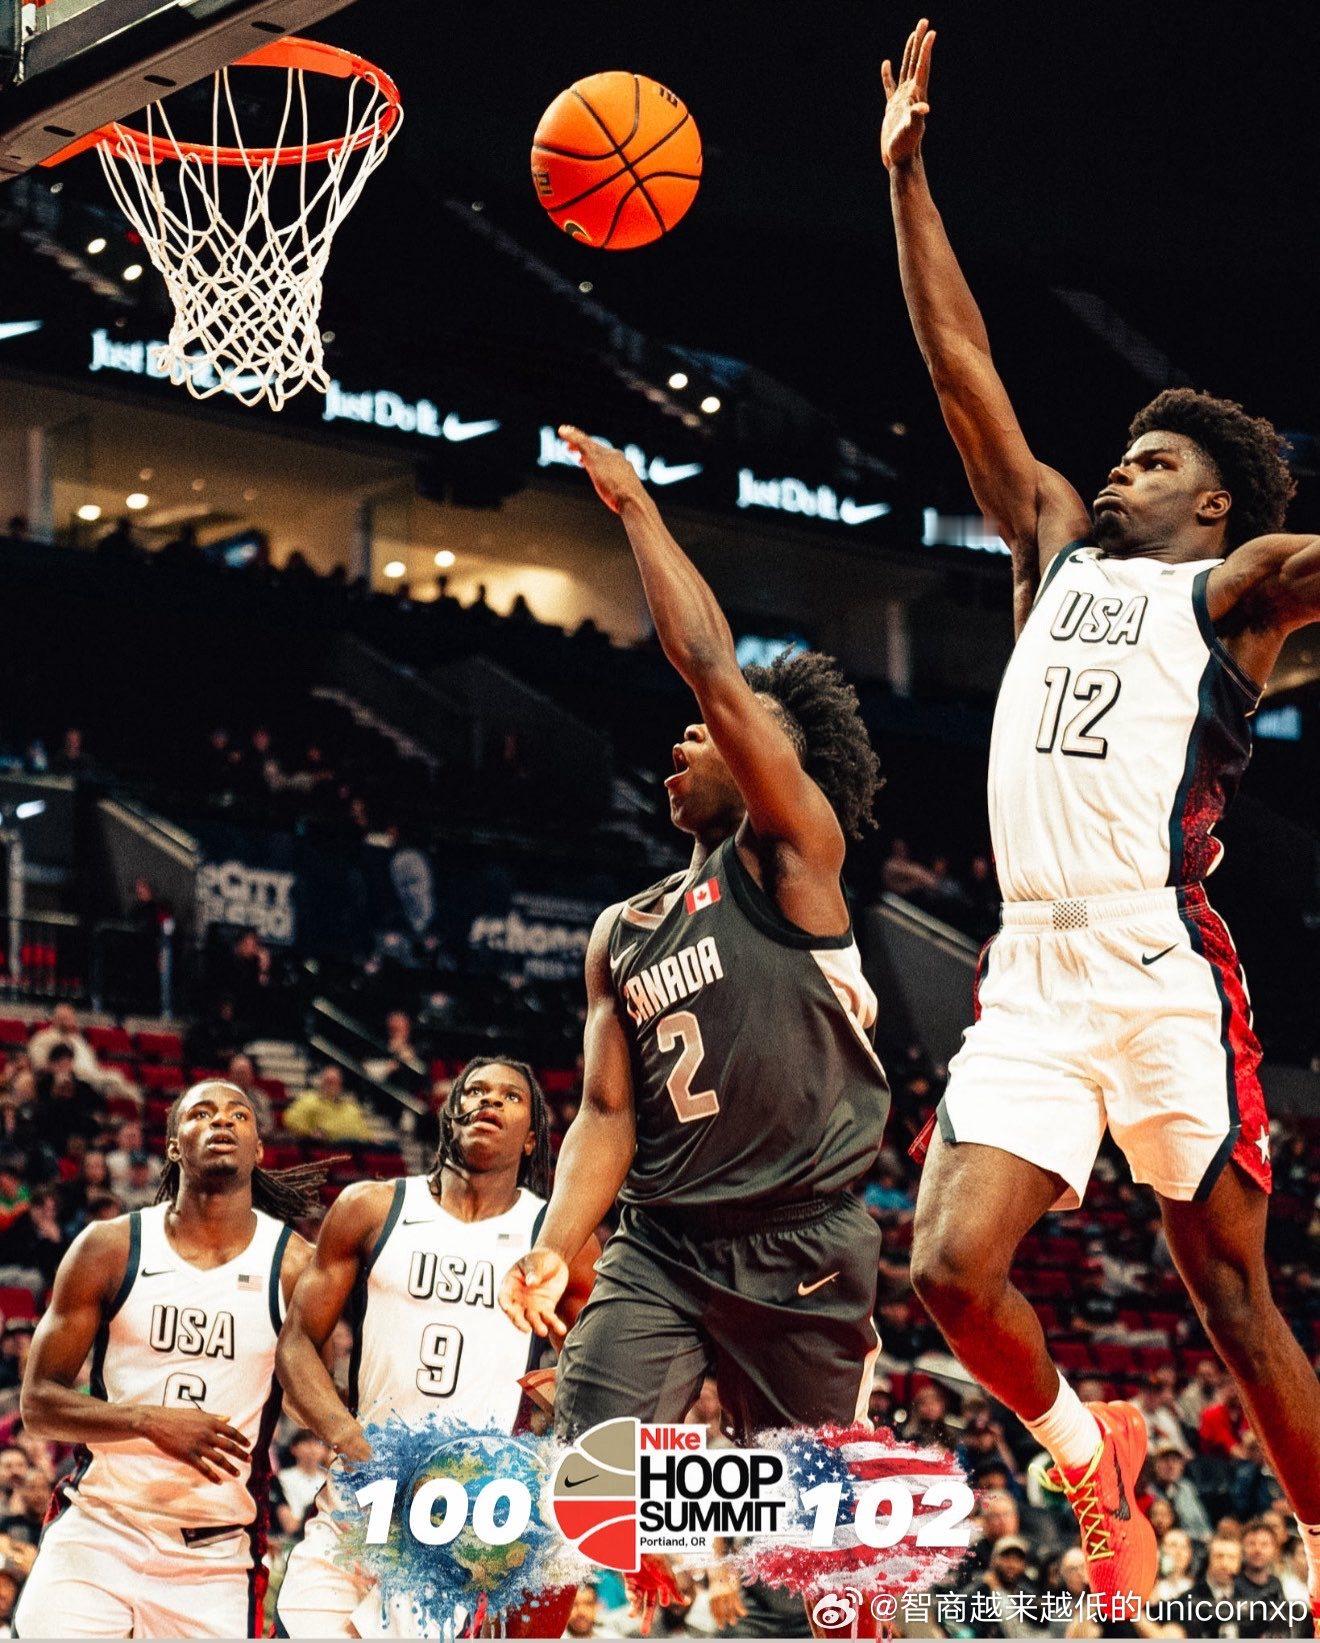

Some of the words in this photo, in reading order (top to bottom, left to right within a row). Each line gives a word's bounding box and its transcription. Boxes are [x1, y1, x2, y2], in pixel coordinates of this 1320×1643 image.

[1050, 590, 1148, 645] USA
[1036, 666, 1121, 760] 12
[656, 1011, 720, 1124] 2
[408, 1251, 495, 1309] USA
[150, 1305, 234, 1360] USA
[416, 1323, 464, 1398] 9
